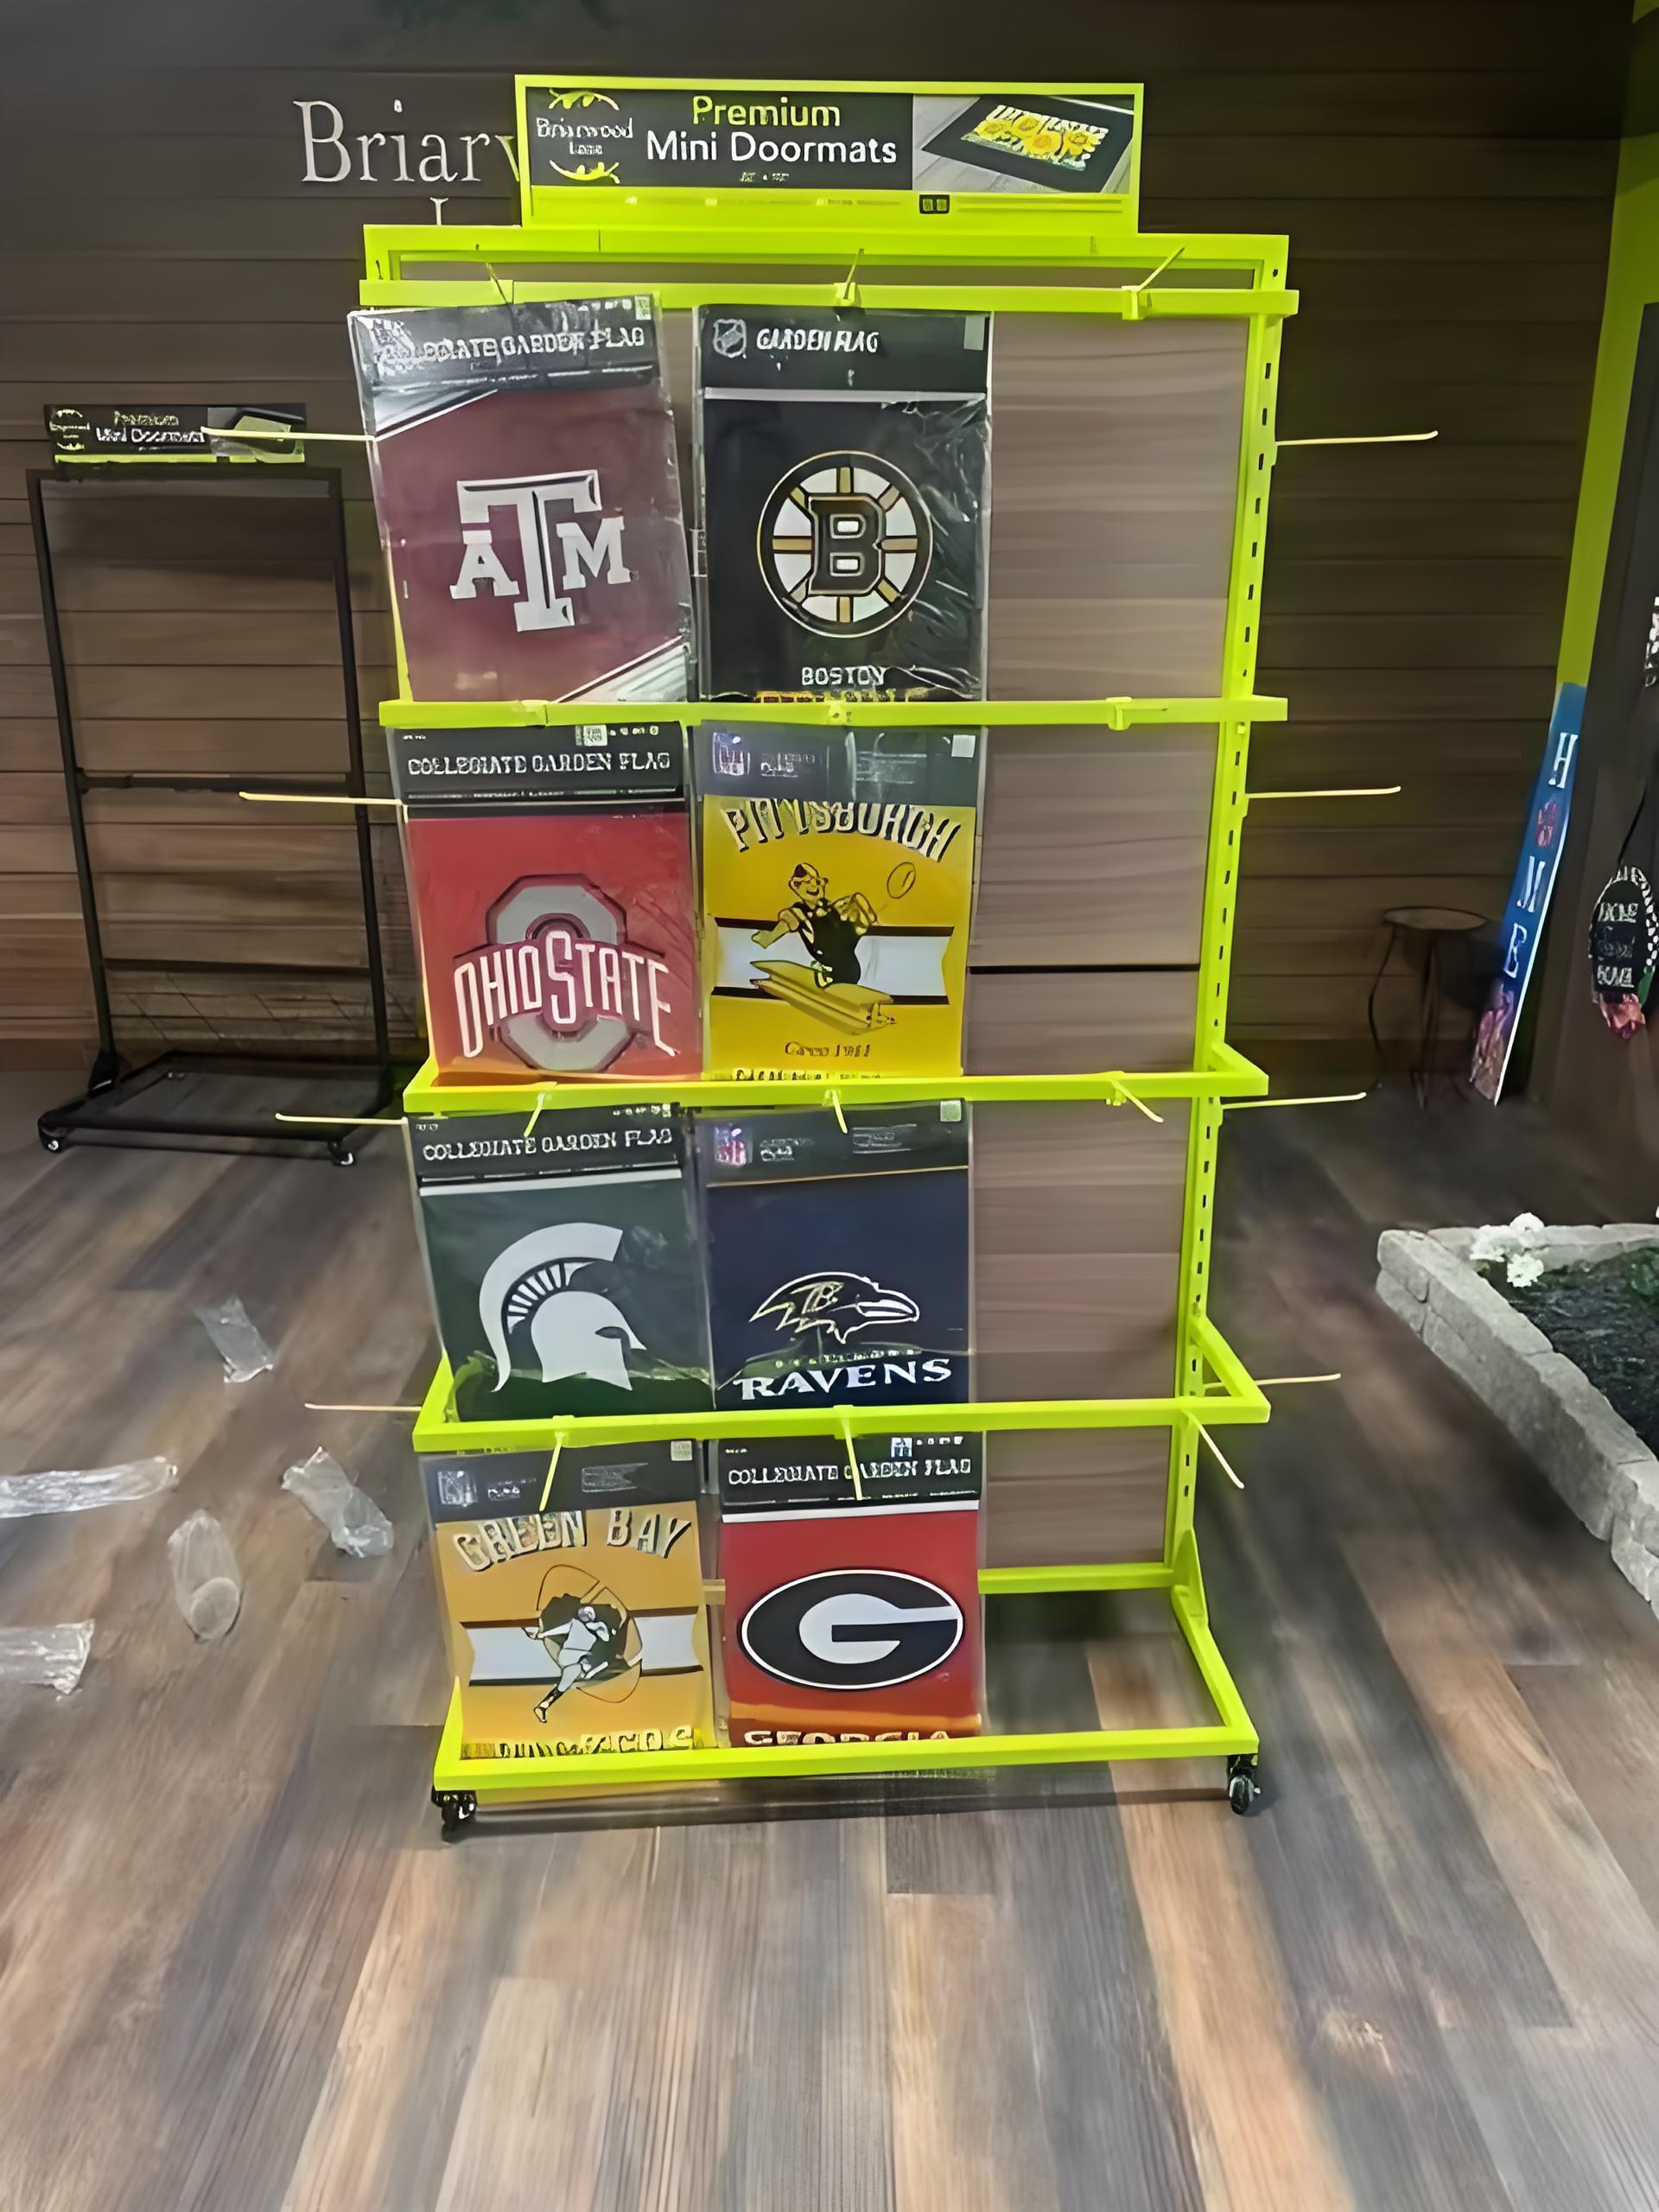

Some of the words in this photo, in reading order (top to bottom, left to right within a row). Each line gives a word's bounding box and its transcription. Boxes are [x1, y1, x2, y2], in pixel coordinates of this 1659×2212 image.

[692, 95, 842, 128] Premium
[647, 130, 717, 162] Mini
[730, 131, 898, 164] Doormats
[801, 666, 887, 686] BOSTON
[733, 1358, 952, 1401] RAVENS
[607, 1506, 692, 1560] BAY
